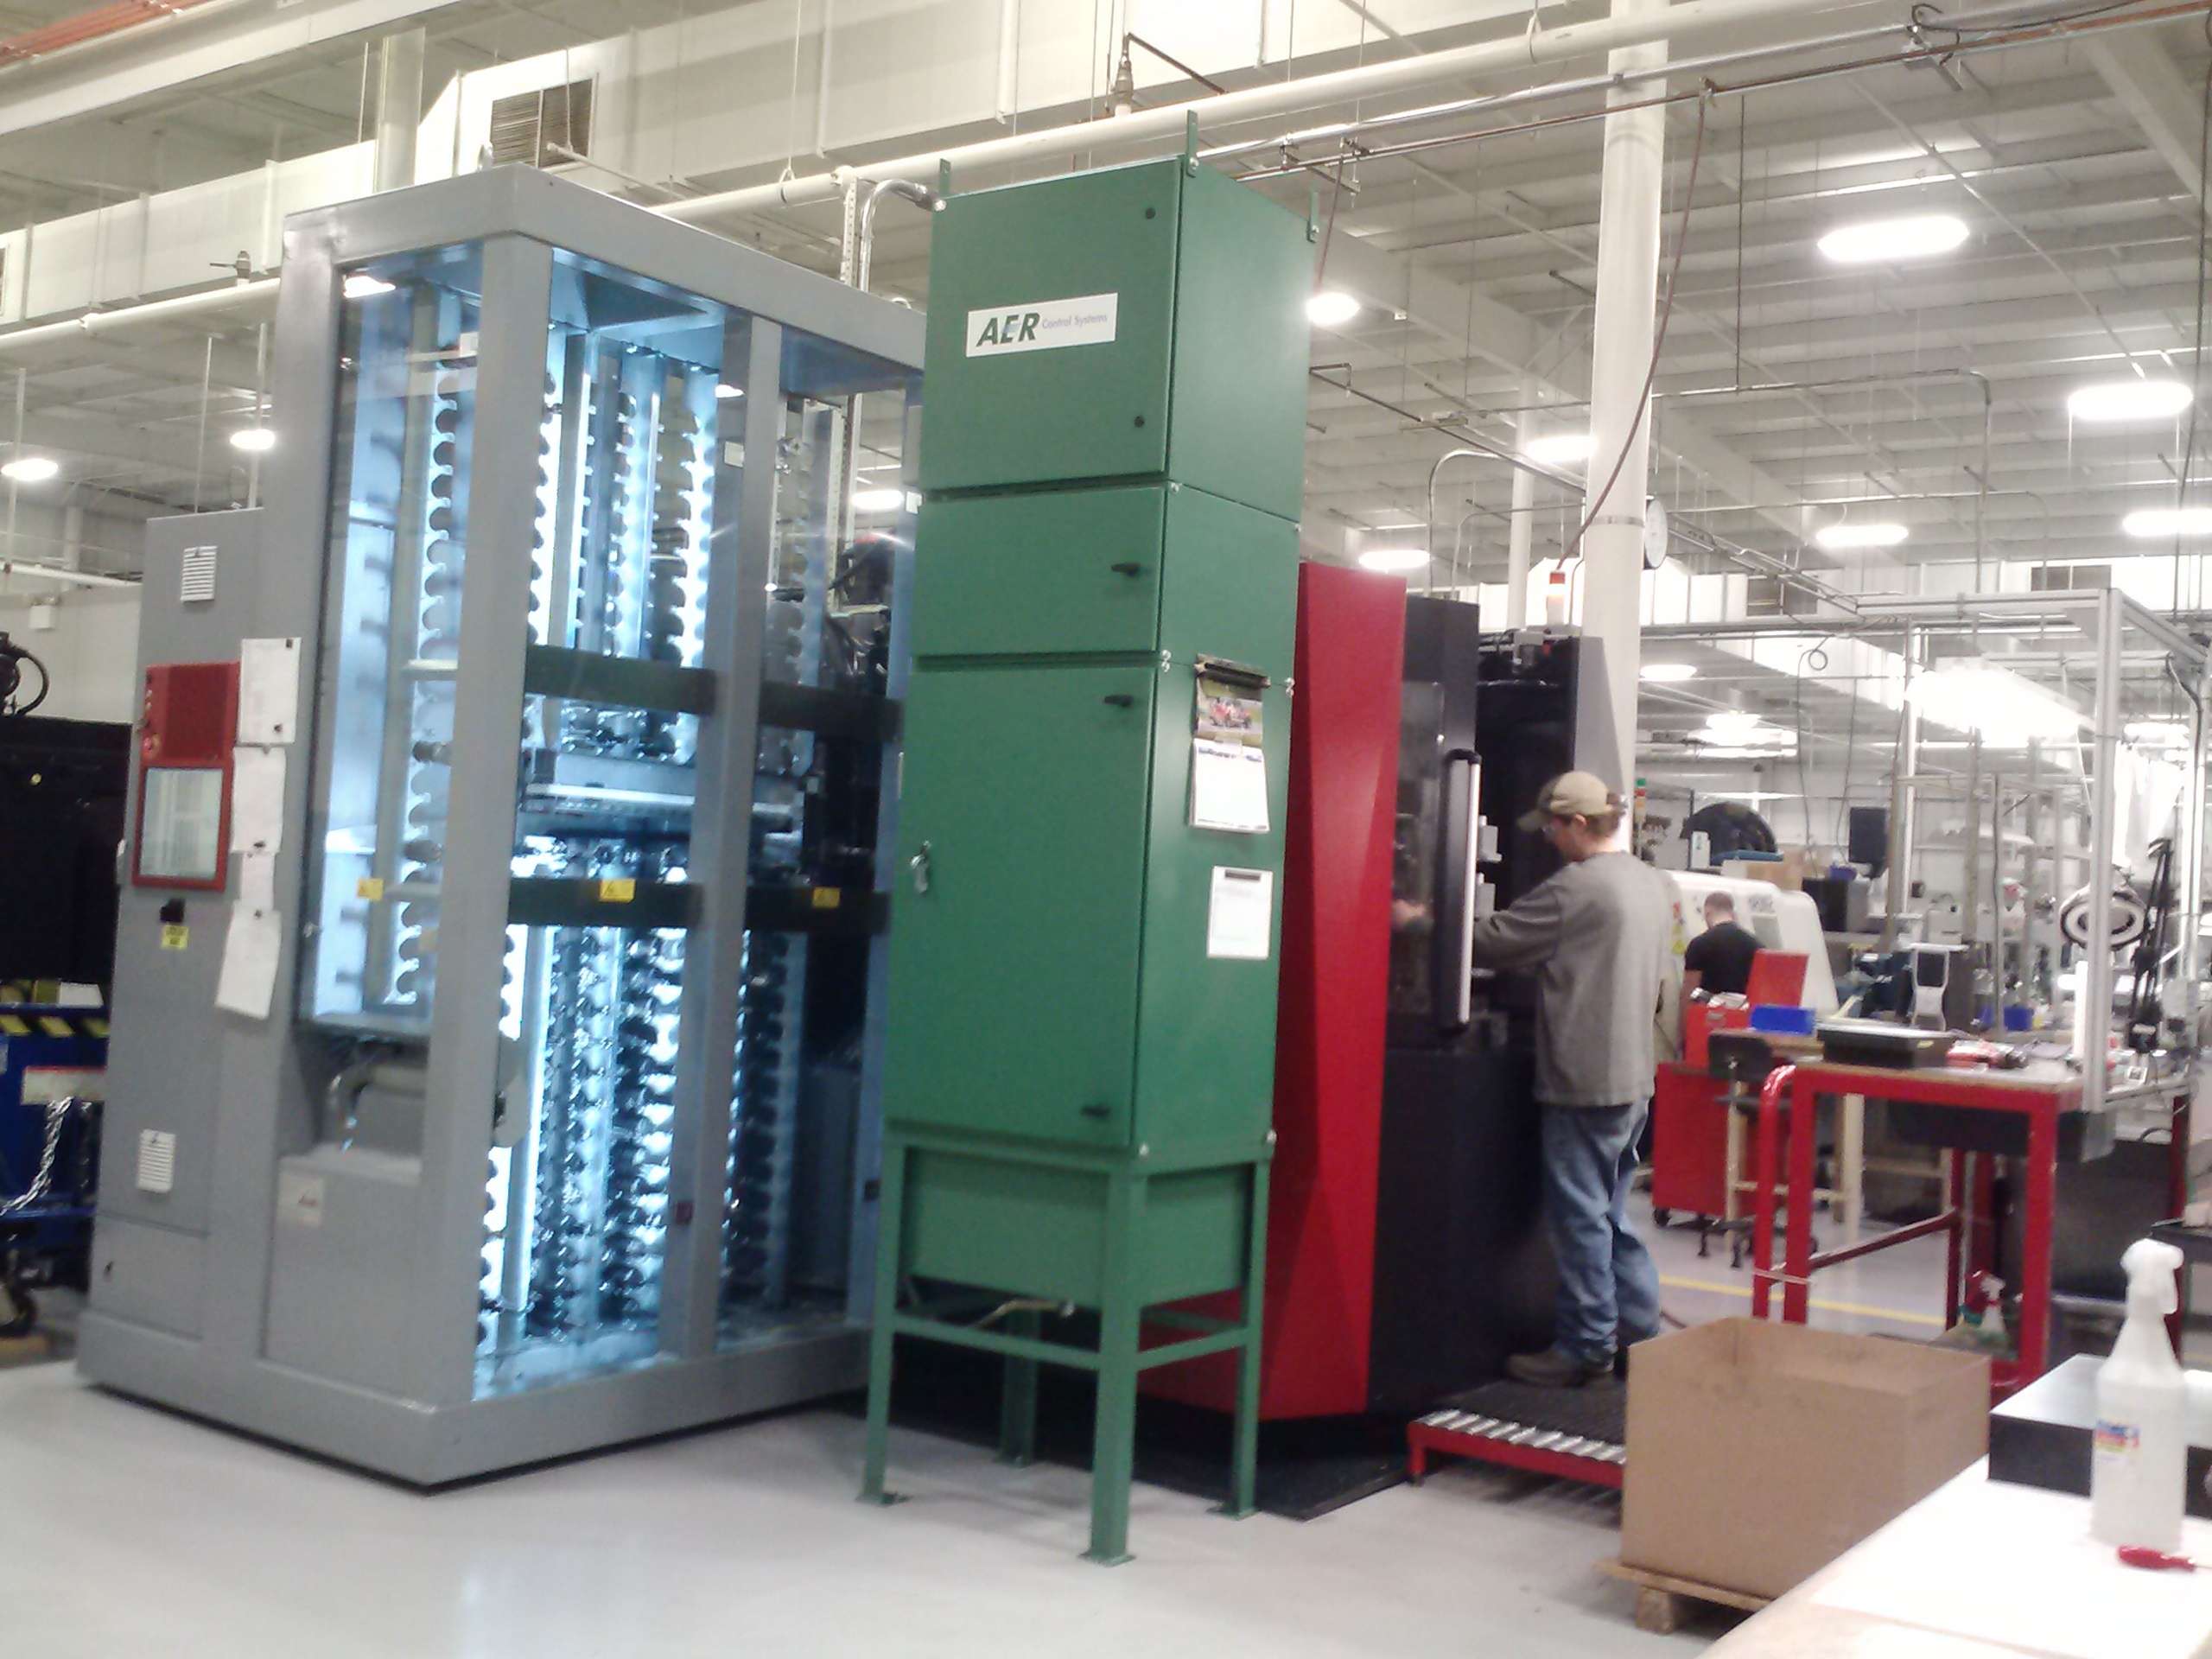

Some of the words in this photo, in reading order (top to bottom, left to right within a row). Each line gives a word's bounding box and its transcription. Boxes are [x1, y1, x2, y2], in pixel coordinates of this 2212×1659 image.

[976, 312, 1040, 347] AER
[1042, 315, 1071, 329] Control
[1074, 314, 1108, 328] Systems
